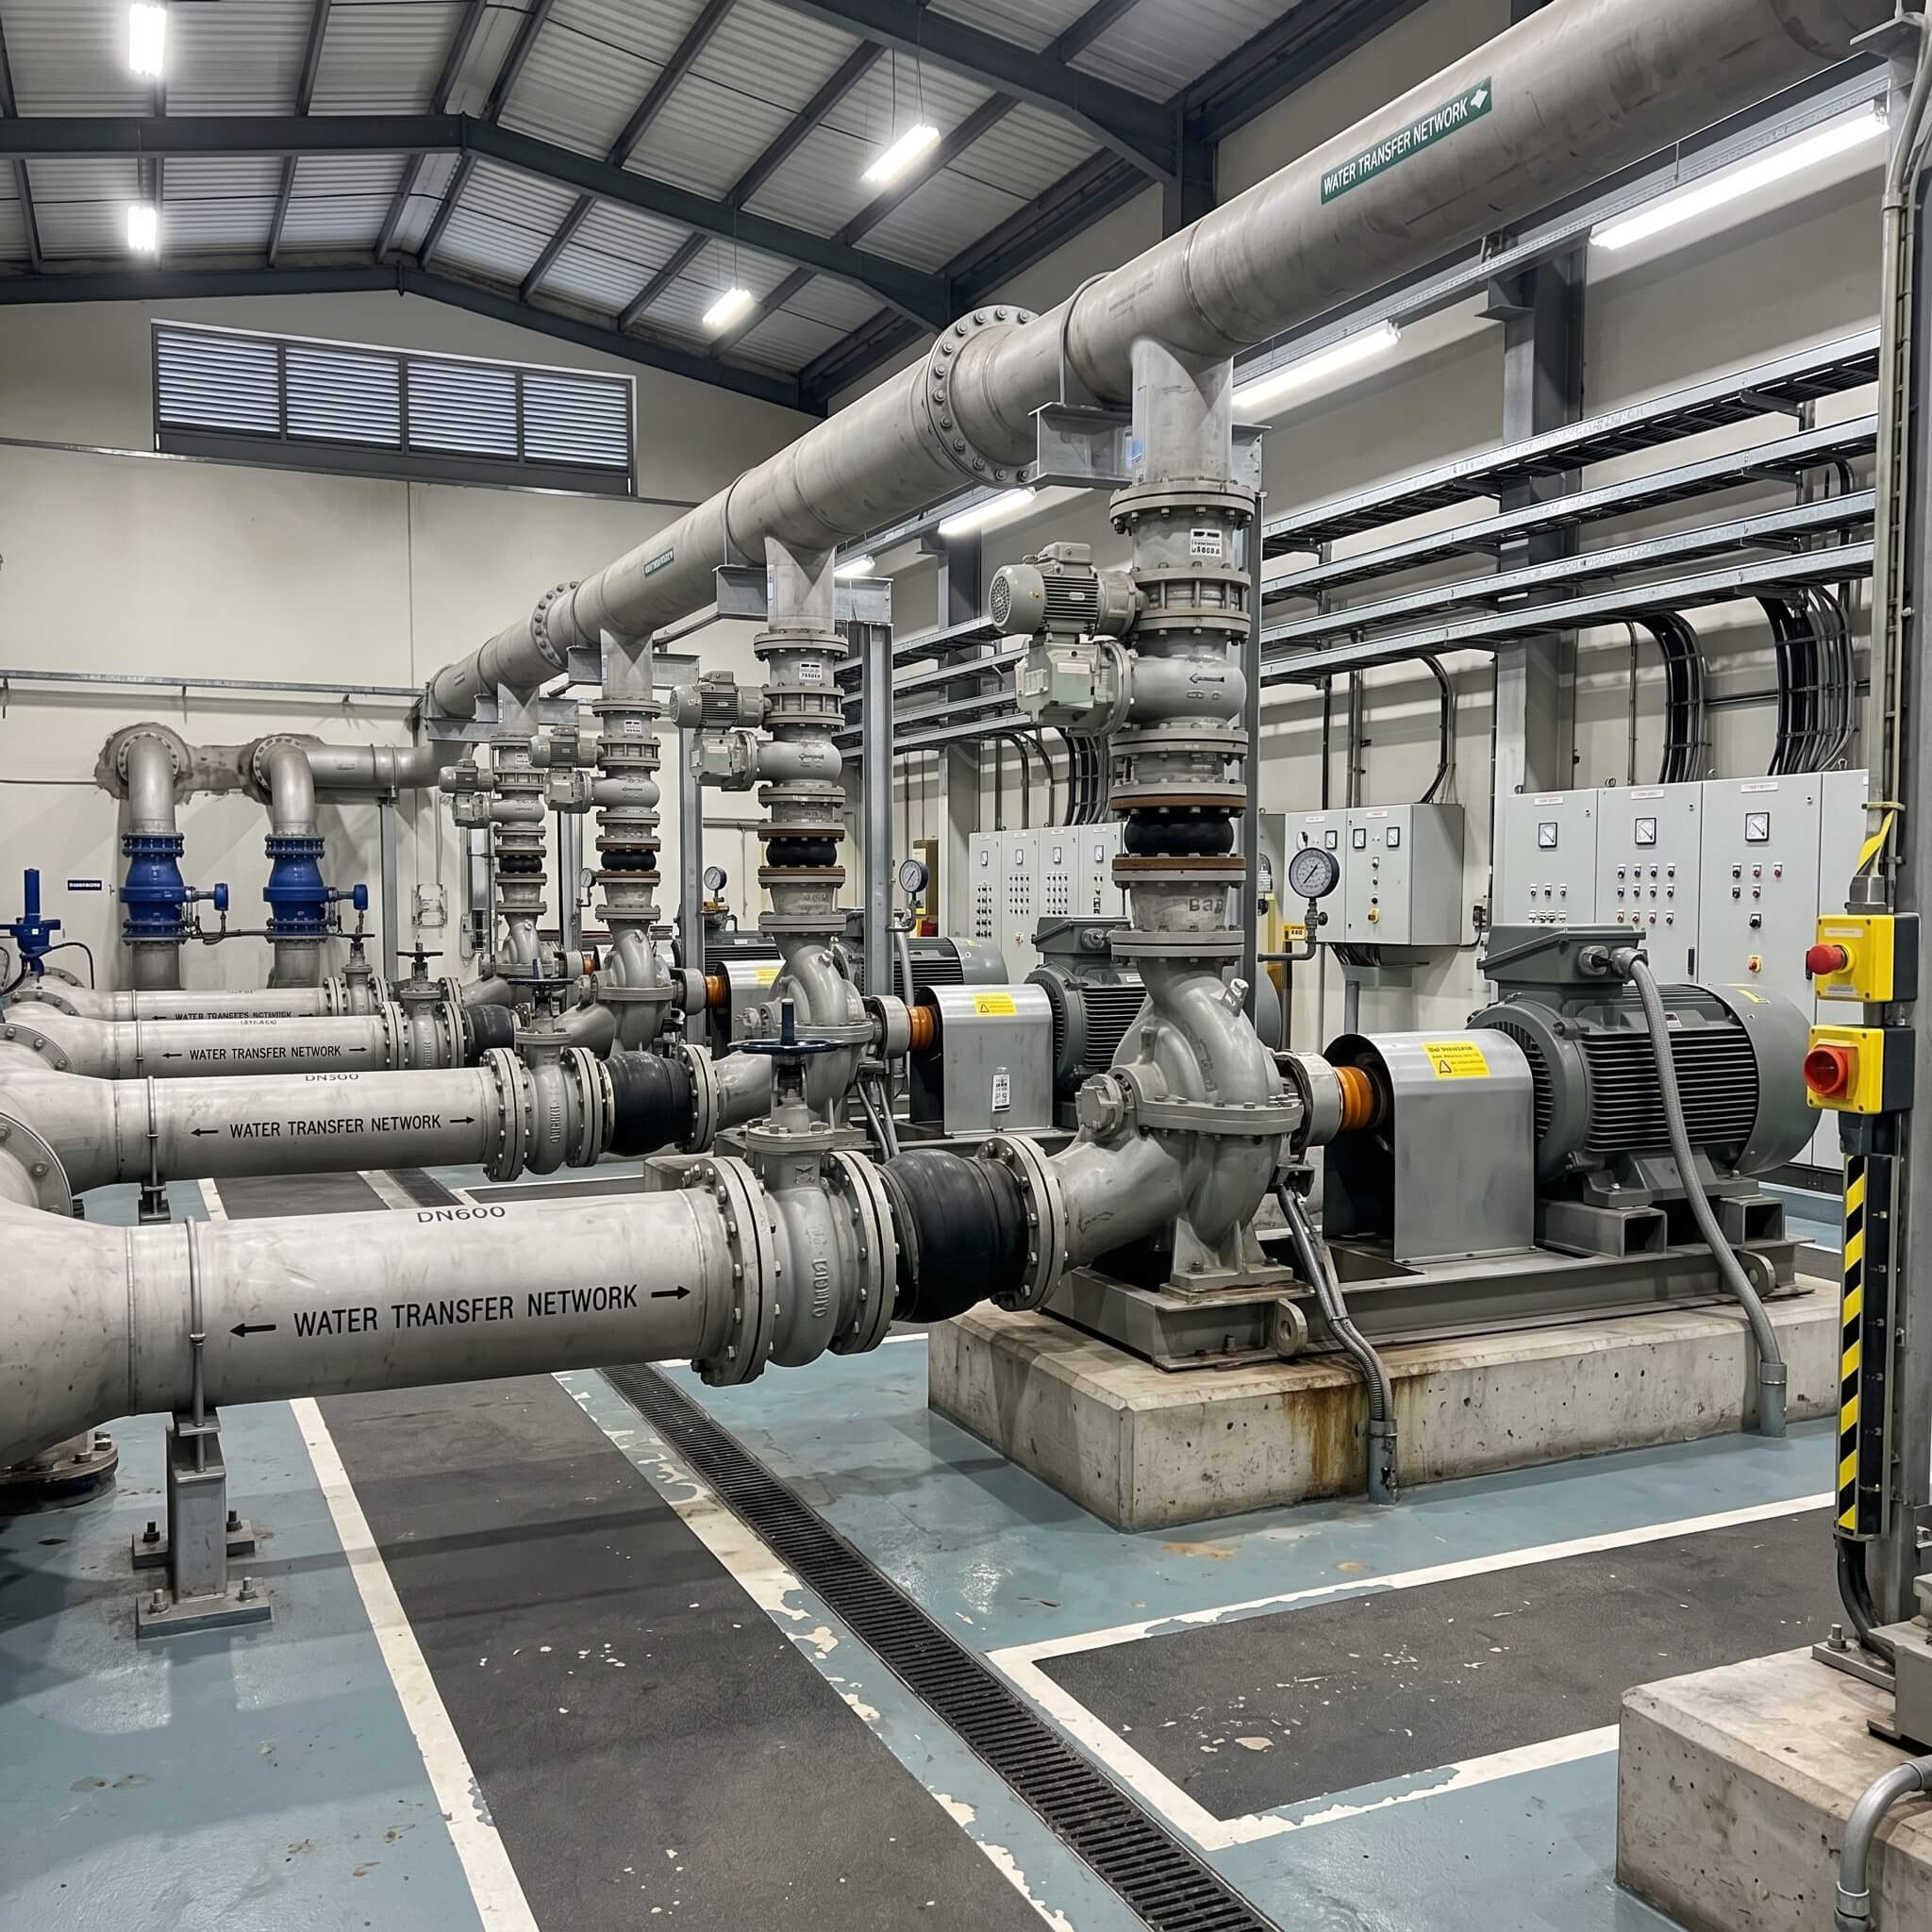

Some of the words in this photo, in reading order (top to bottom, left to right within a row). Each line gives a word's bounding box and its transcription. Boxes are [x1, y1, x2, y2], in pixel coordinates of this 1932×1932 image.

[1324, 162, 1357, 195] WATER
[1357, 131, 1411, 175] TRANSFER
[1413, 97, 1469, 145] NETWORK
[190, 1048, 226, 1061] WATER
[231, 1047, 287, 1059] TRANSFER
[291, 1045, 341, 1058] NETWORK
[229, 1123, 281, 1139] WATER
[288, 1118, 364, 1136] TRANSFER
[371, 1114, 441, 1132] NETWORK
[416, 1206, 507, 1224] DN600
[293, 1307, 377, 1338] WATER
[391, 1295, 514, 1329] TRANSFER
[527, 1284, 638, 1317] NETWORK
